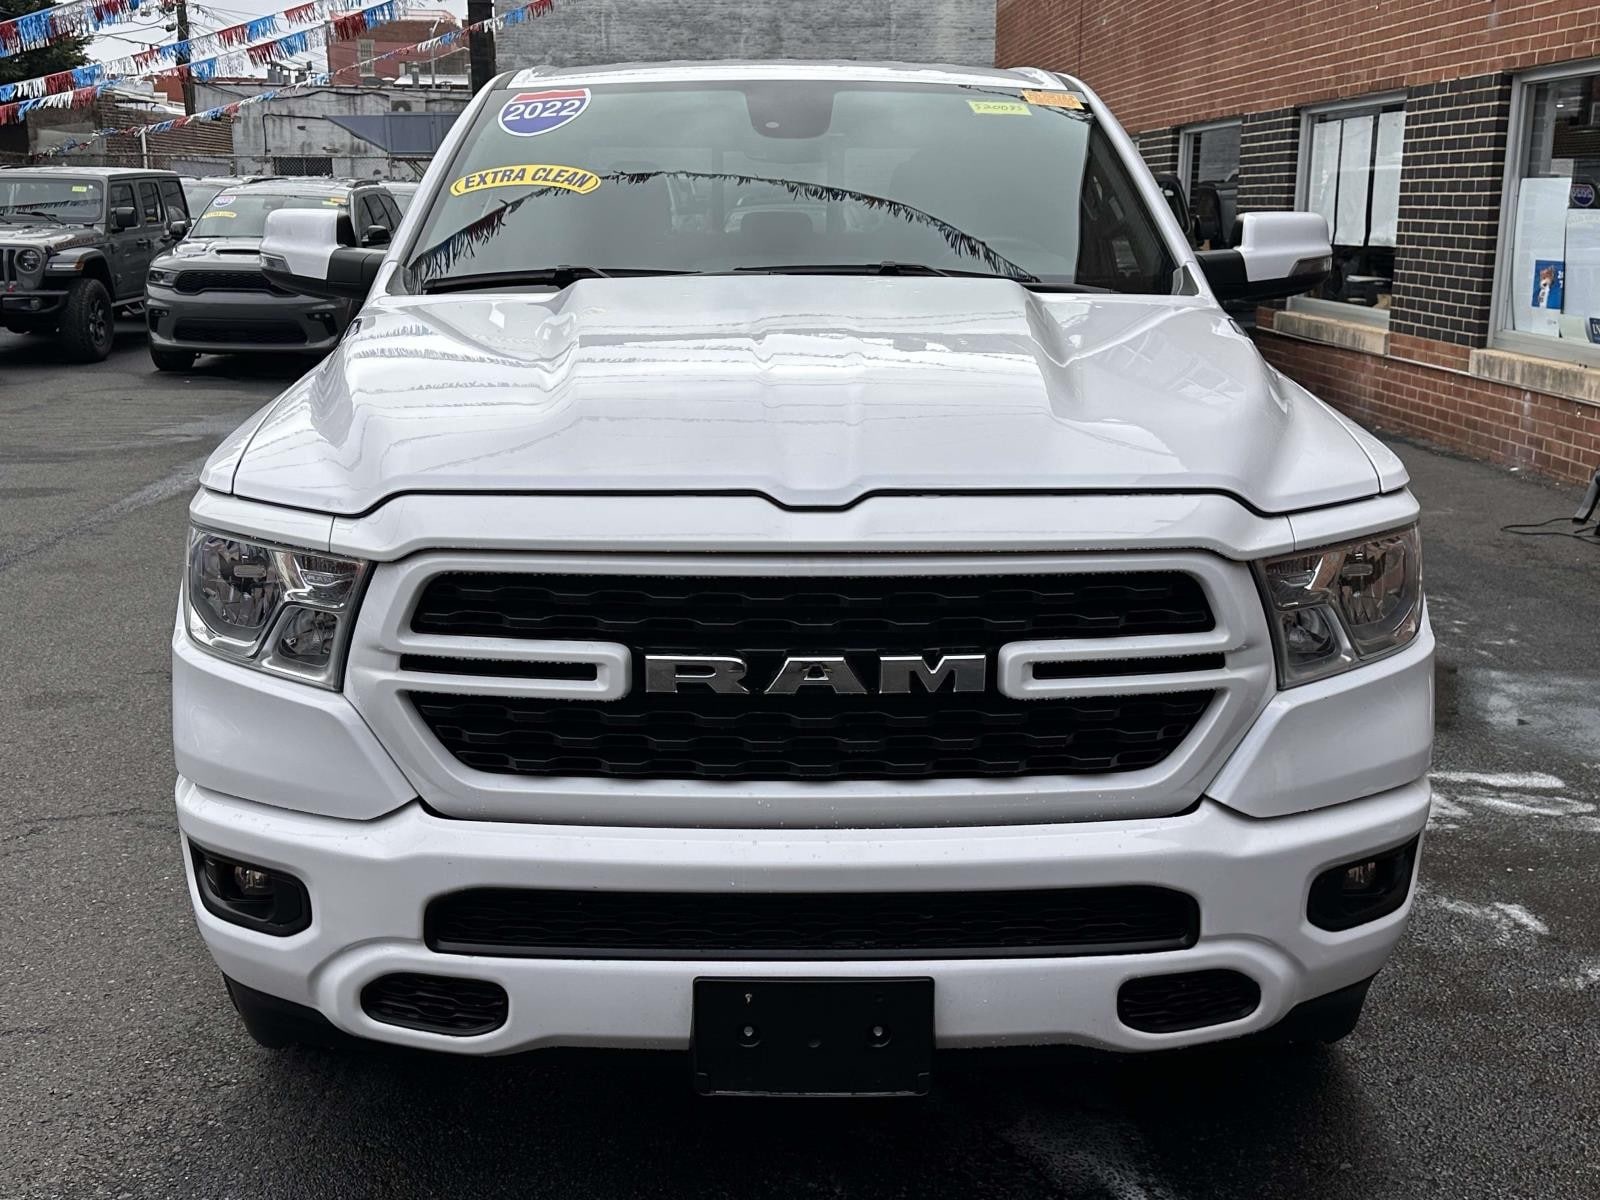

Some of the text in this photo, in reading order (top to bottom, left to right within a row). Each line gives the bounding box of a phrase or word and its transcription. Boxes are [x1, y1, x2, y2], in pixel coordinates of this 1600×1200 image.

[503, 99, 581, 121] 2022
[464, 167, 594, 190] EXTRA CLEAN
[645, 655, 986, 695] RAM
